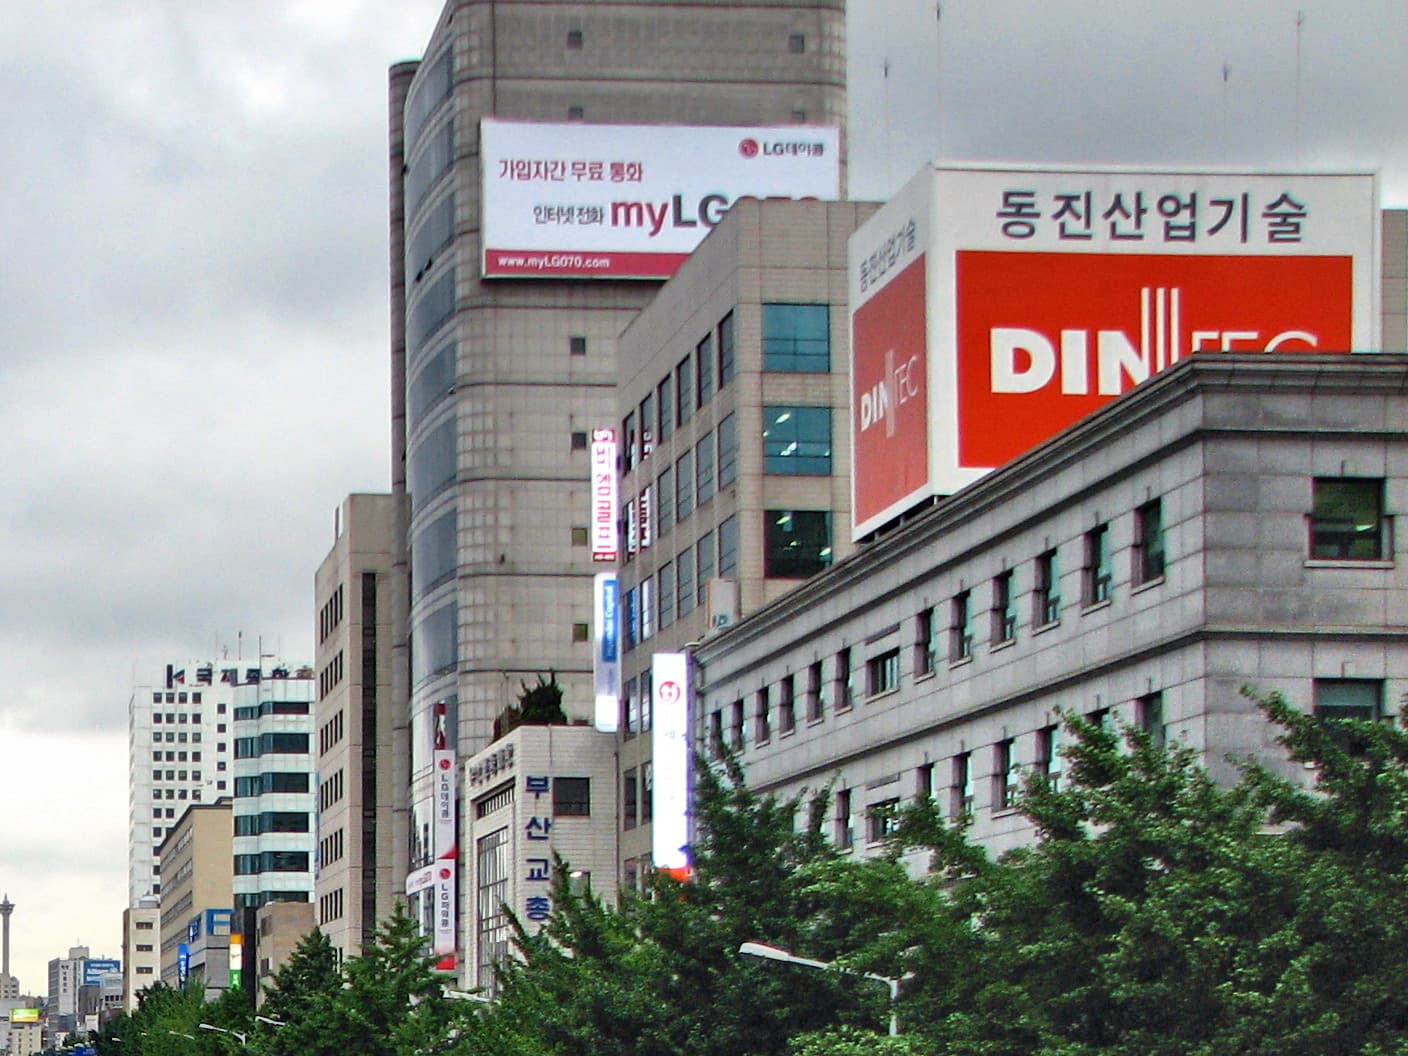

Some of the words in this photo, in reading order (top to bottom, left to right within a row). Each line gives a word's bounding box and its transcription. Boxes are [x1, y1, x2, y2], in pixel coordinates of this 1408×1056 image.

[498, 160, 566, 181] 가입자간
[571, 162, 604, 182] 무료
[609, 163, 643, 183] 통화
[533, 206, 575, 225] 인터넷
[576, 206, 604, 225] 전화
[996, 190, 1308, 244] 동진산업기술
[498, 256, 610, 269] www.myLG070.com
[525, 776, 551, 920] 부산교총
